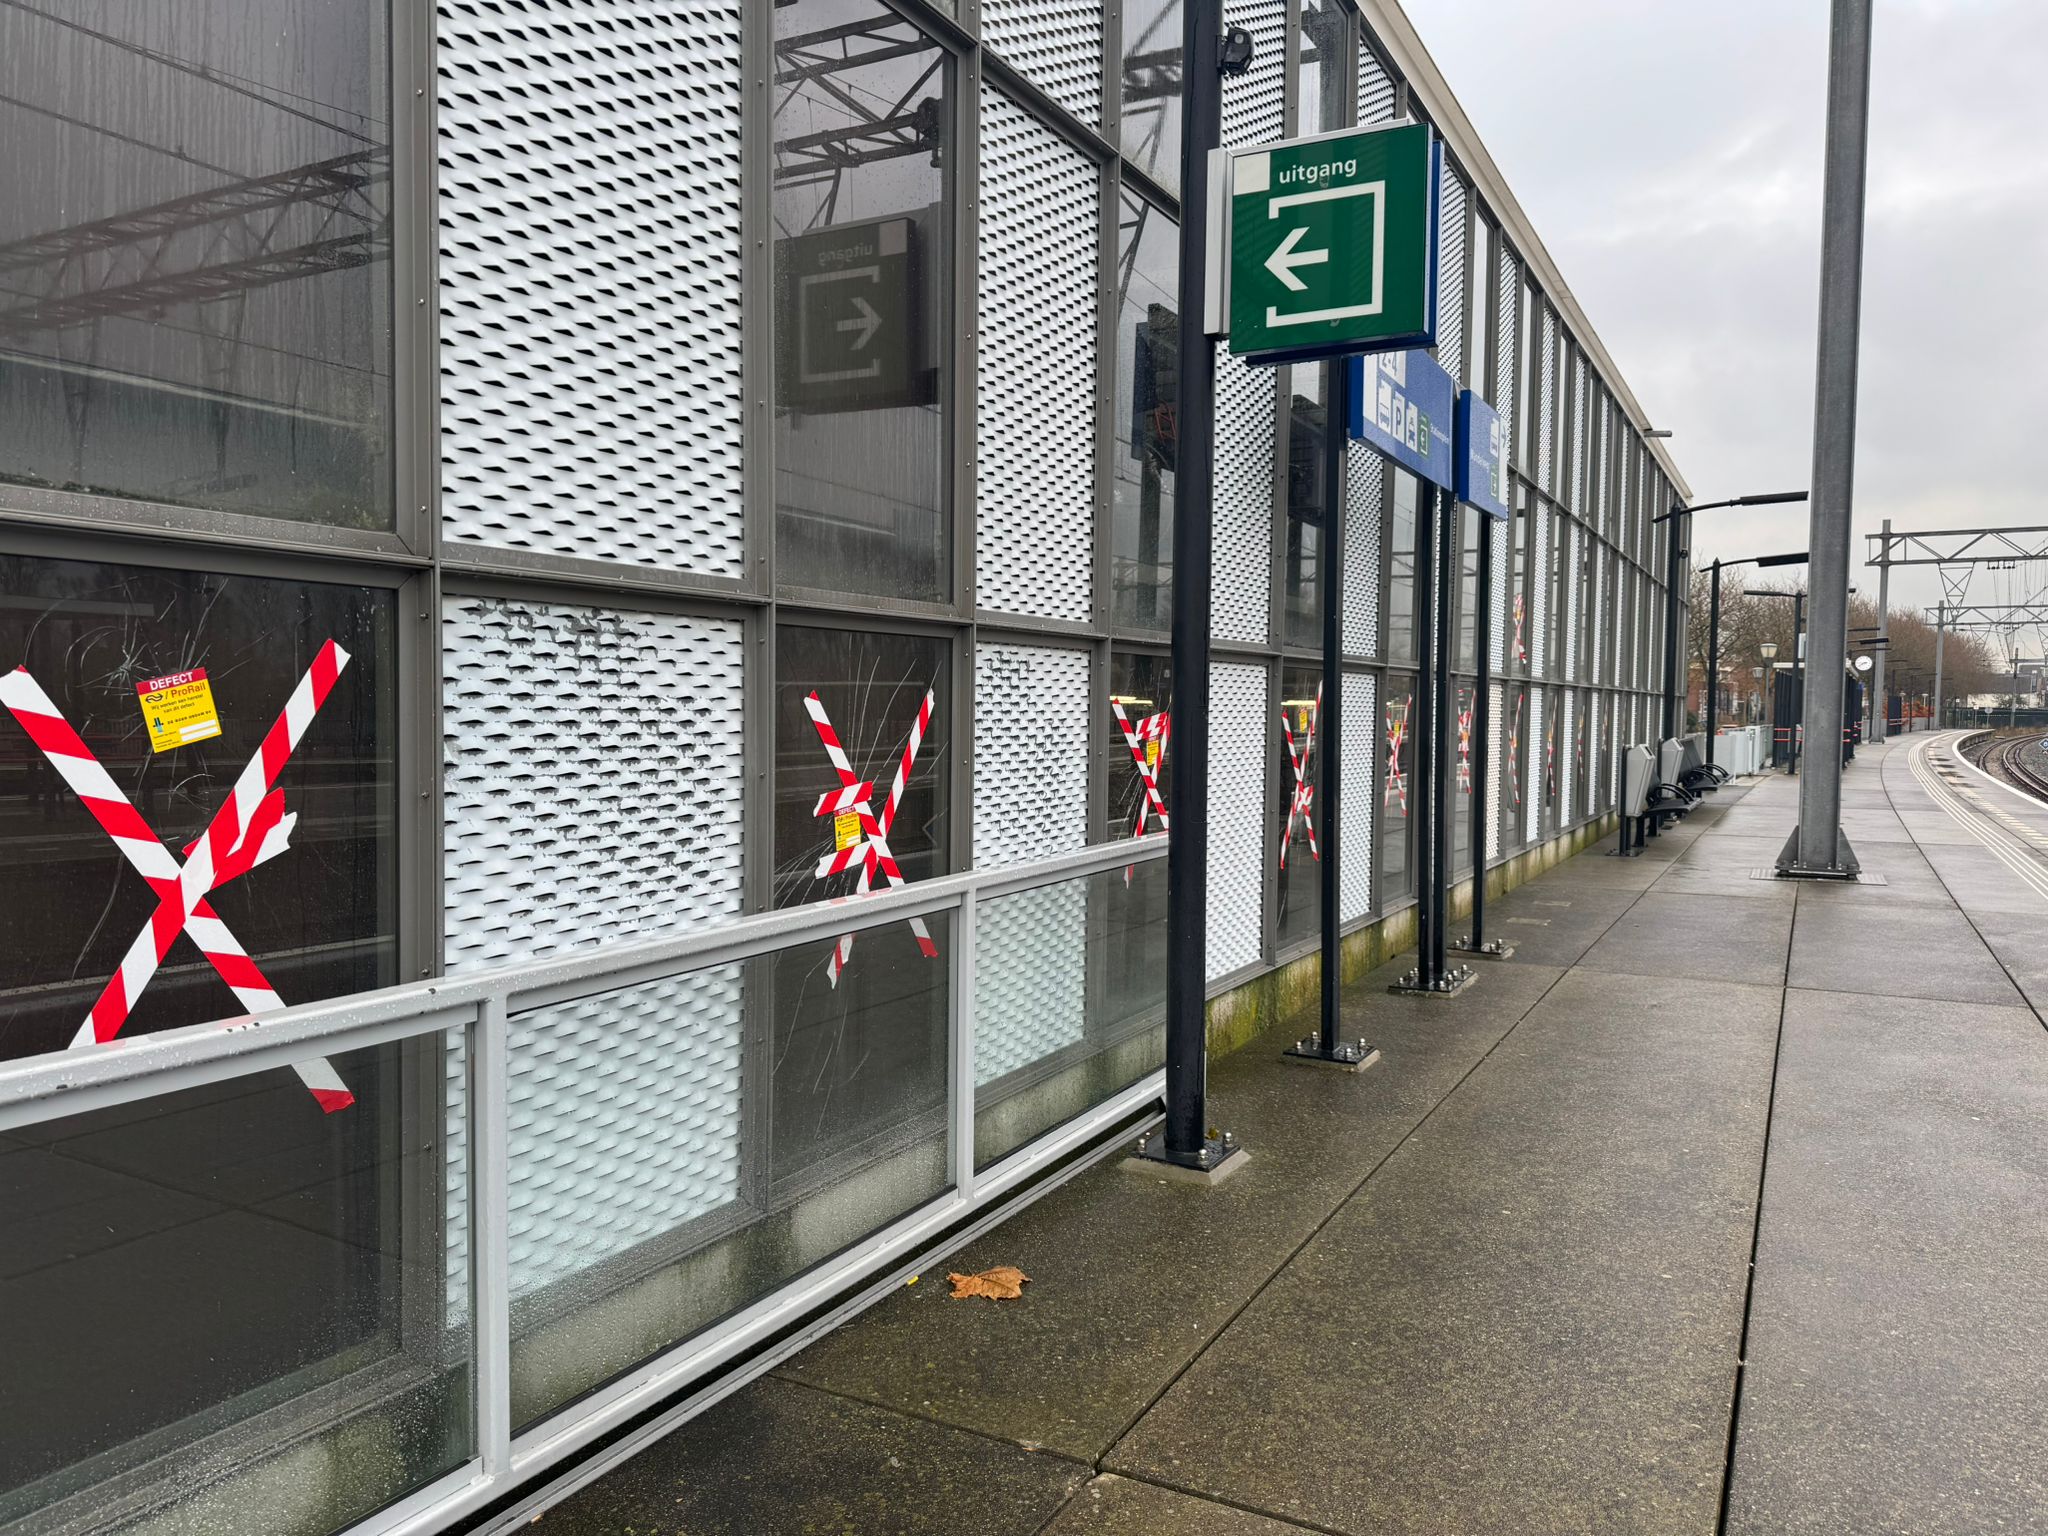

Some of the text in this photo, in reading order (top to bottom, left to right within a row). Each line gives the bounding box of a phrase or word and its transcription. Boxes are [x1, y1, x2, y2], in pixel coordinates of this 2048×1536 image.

[1279, 159, 1357, 184] uitgang
[149, 671, 193, 691] DEFECT
[171, 682, 206, 698] ProRail
